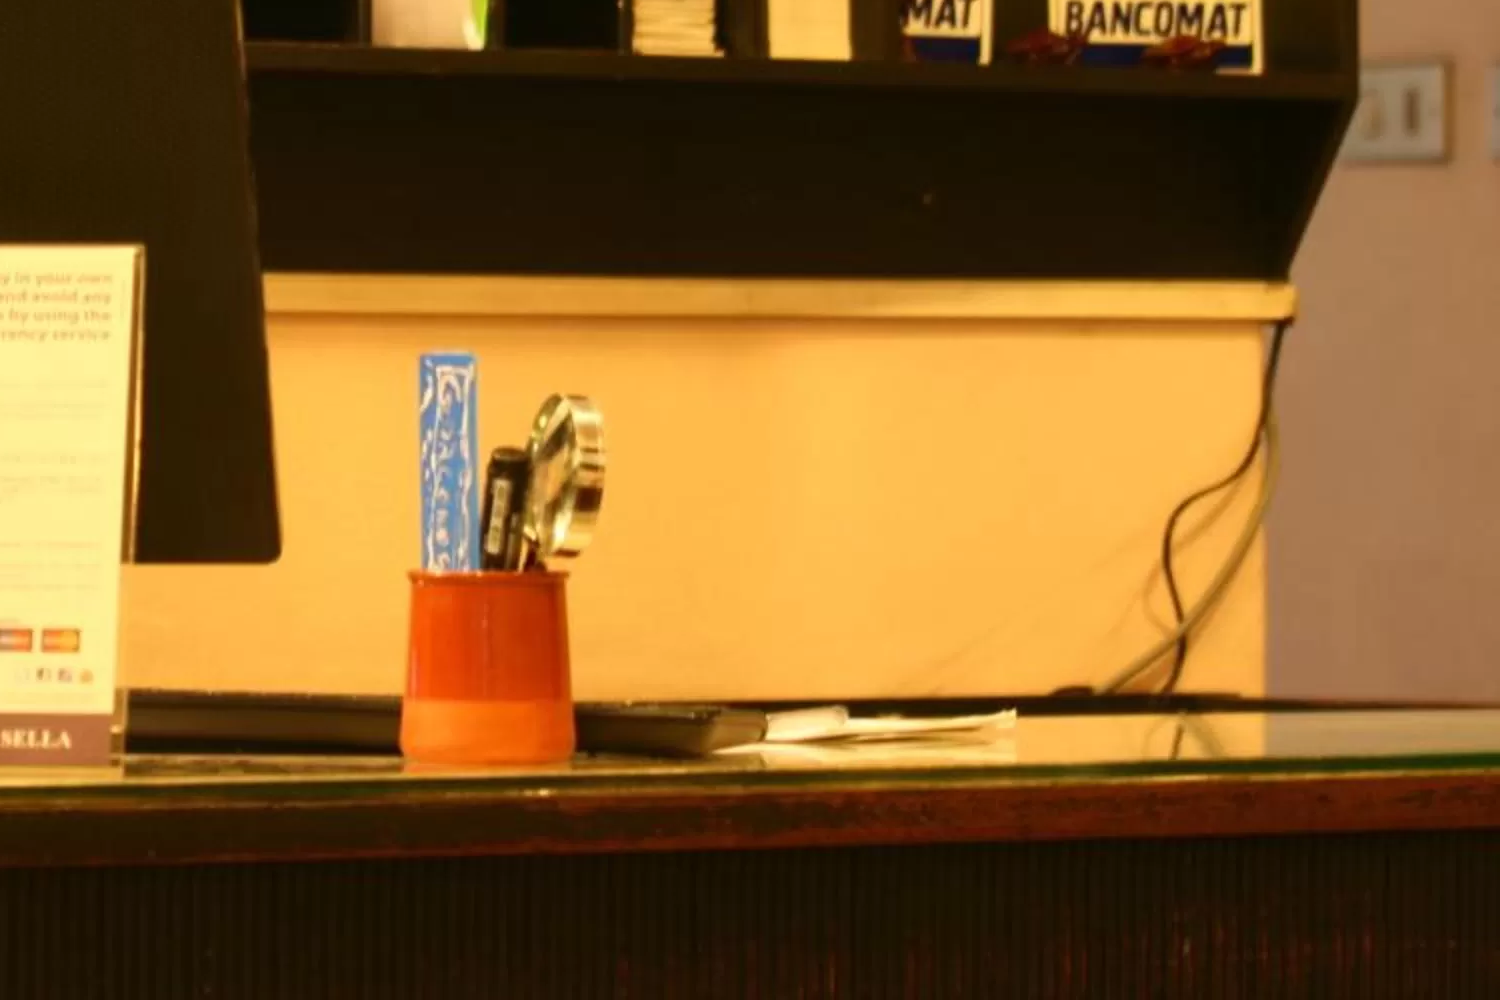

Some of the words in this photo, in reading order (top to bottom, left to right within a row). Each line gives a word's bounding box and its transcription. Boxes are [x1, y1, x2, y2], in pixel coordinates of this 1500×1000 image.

[1065, 0, 1248, 39] BANCOMAT
[15, 271, 31, 284] in
[36, 272, 72, 287] your
[32, 289, 78, 304] avoid
[83, 292, 111, 305] any
[8, 308, 29, 325] by
[33, 309, 79, 324] using
[83, 309, 111, 321] the
[52, 328, 111, 341] service
[0, 728, 72, 750] SELLA
